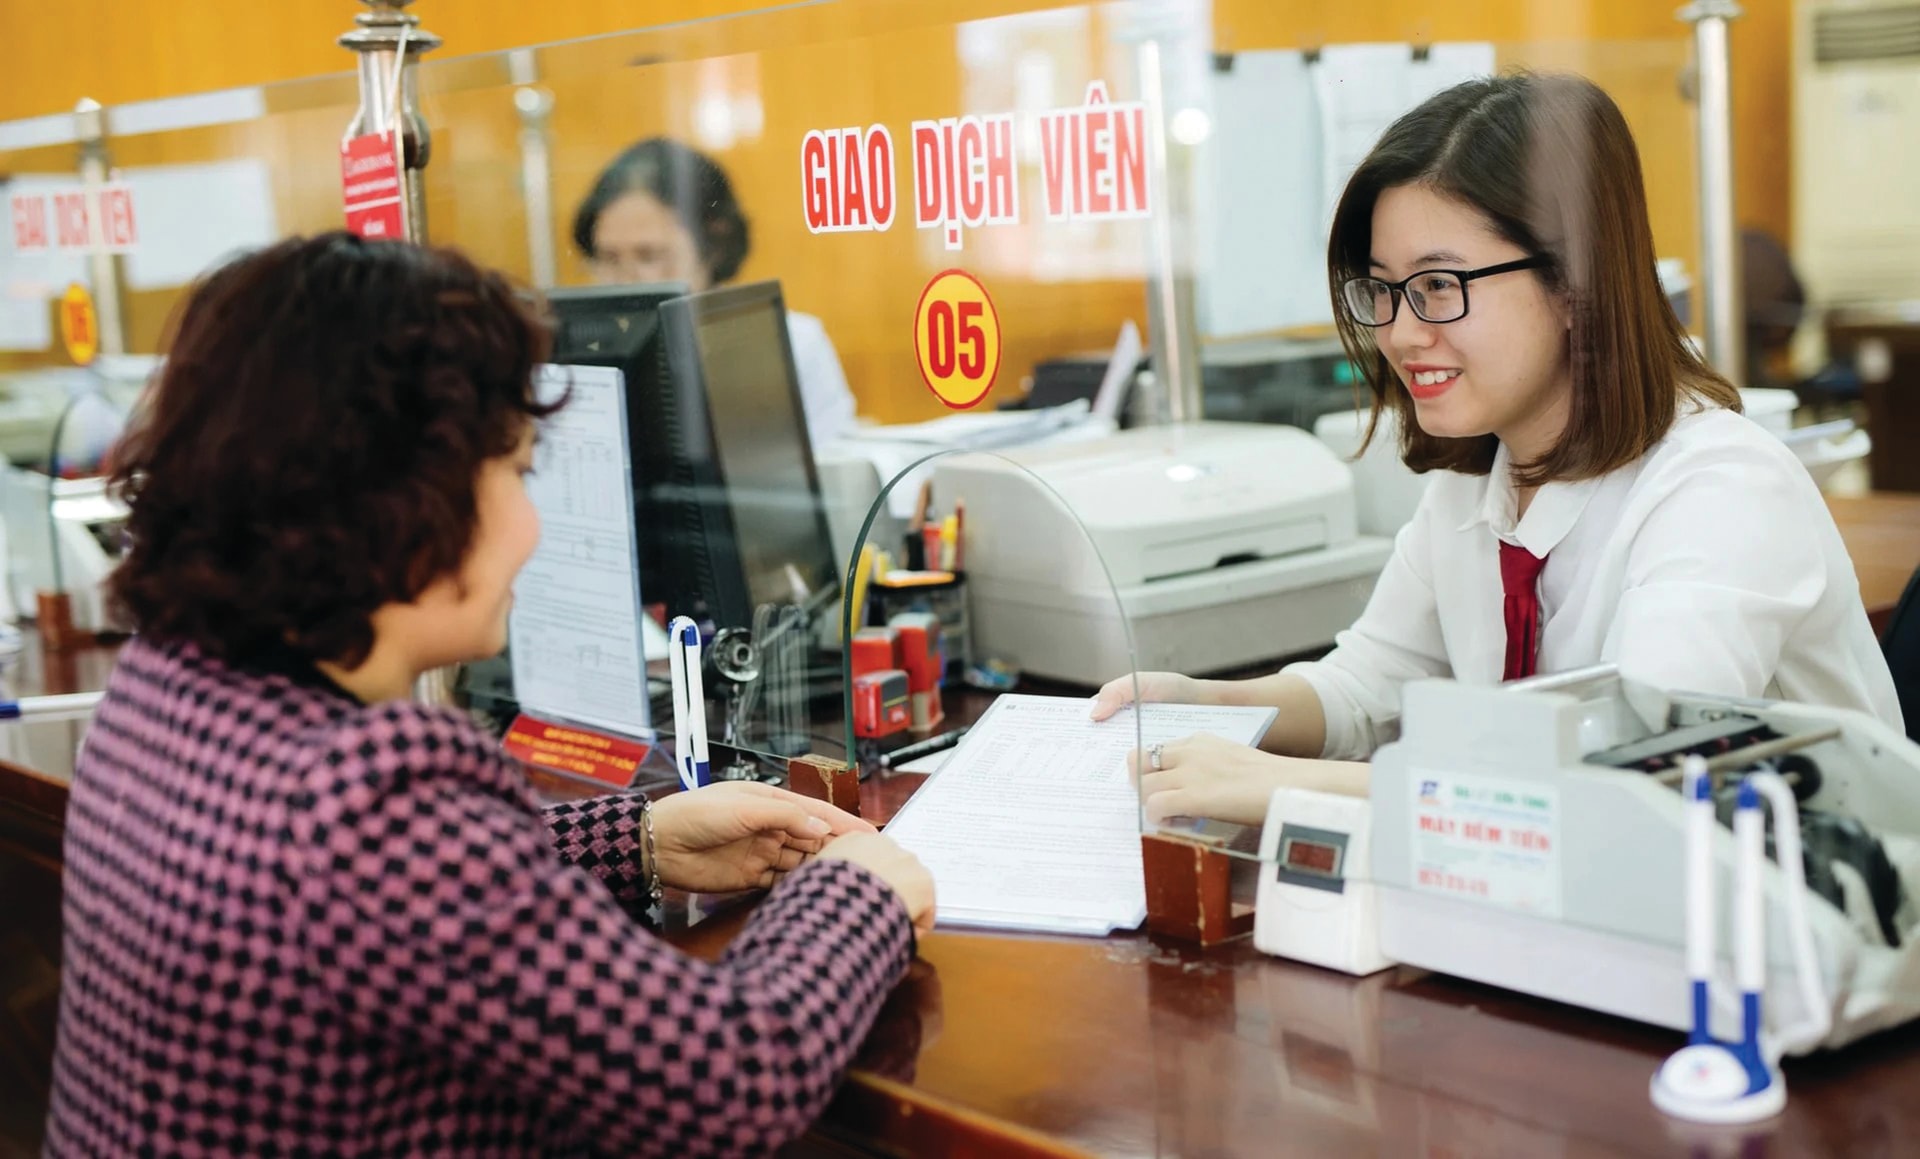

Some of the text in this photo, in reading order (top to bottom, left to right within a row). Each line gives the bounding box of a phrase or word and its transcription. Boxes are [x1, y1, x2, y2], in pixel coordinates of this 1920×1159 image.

[802, 82, 1150, 248] GIAO DỊCH VIÊN
[928, 300, 986, 380] 05
